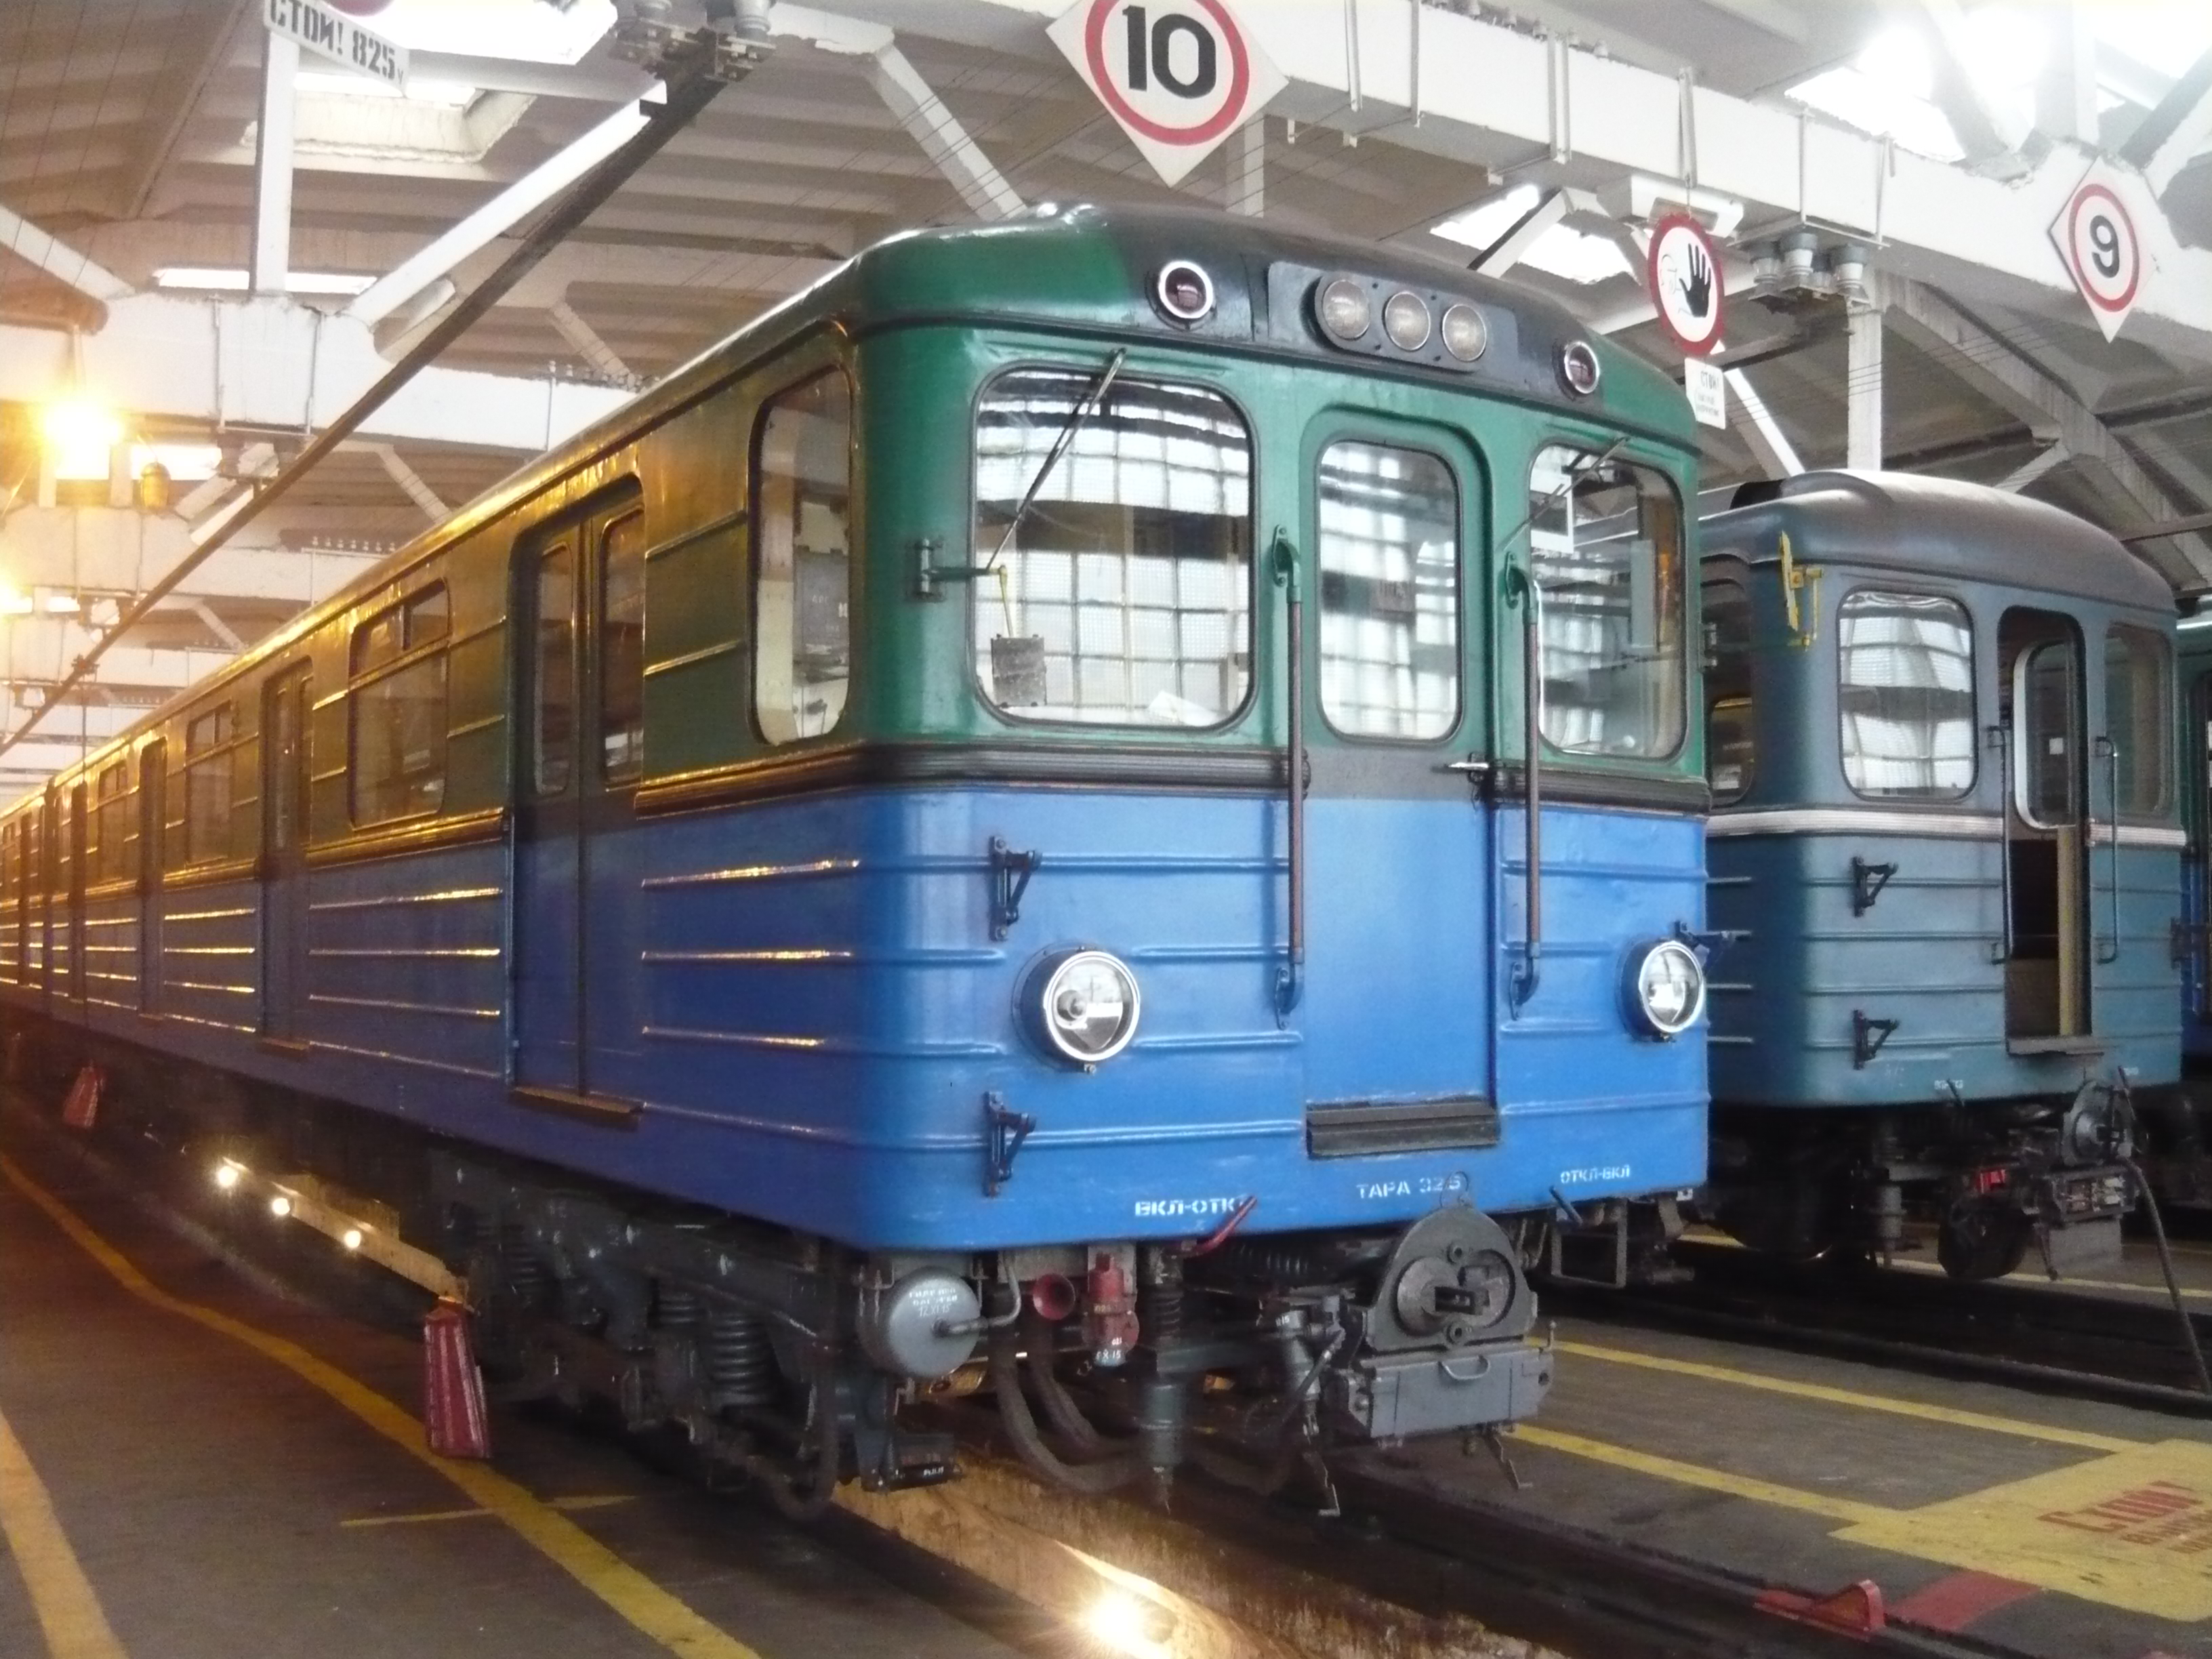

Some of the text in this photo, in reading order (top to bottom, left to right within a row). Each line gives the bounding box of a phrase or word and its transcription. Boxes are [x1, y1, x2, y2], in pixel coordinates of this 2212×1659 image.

[1122, 5, 1216, 99] 10
[2089, 215, 2120, 279] 9
[1356, 1181, 1411, 1199] ТАРА
